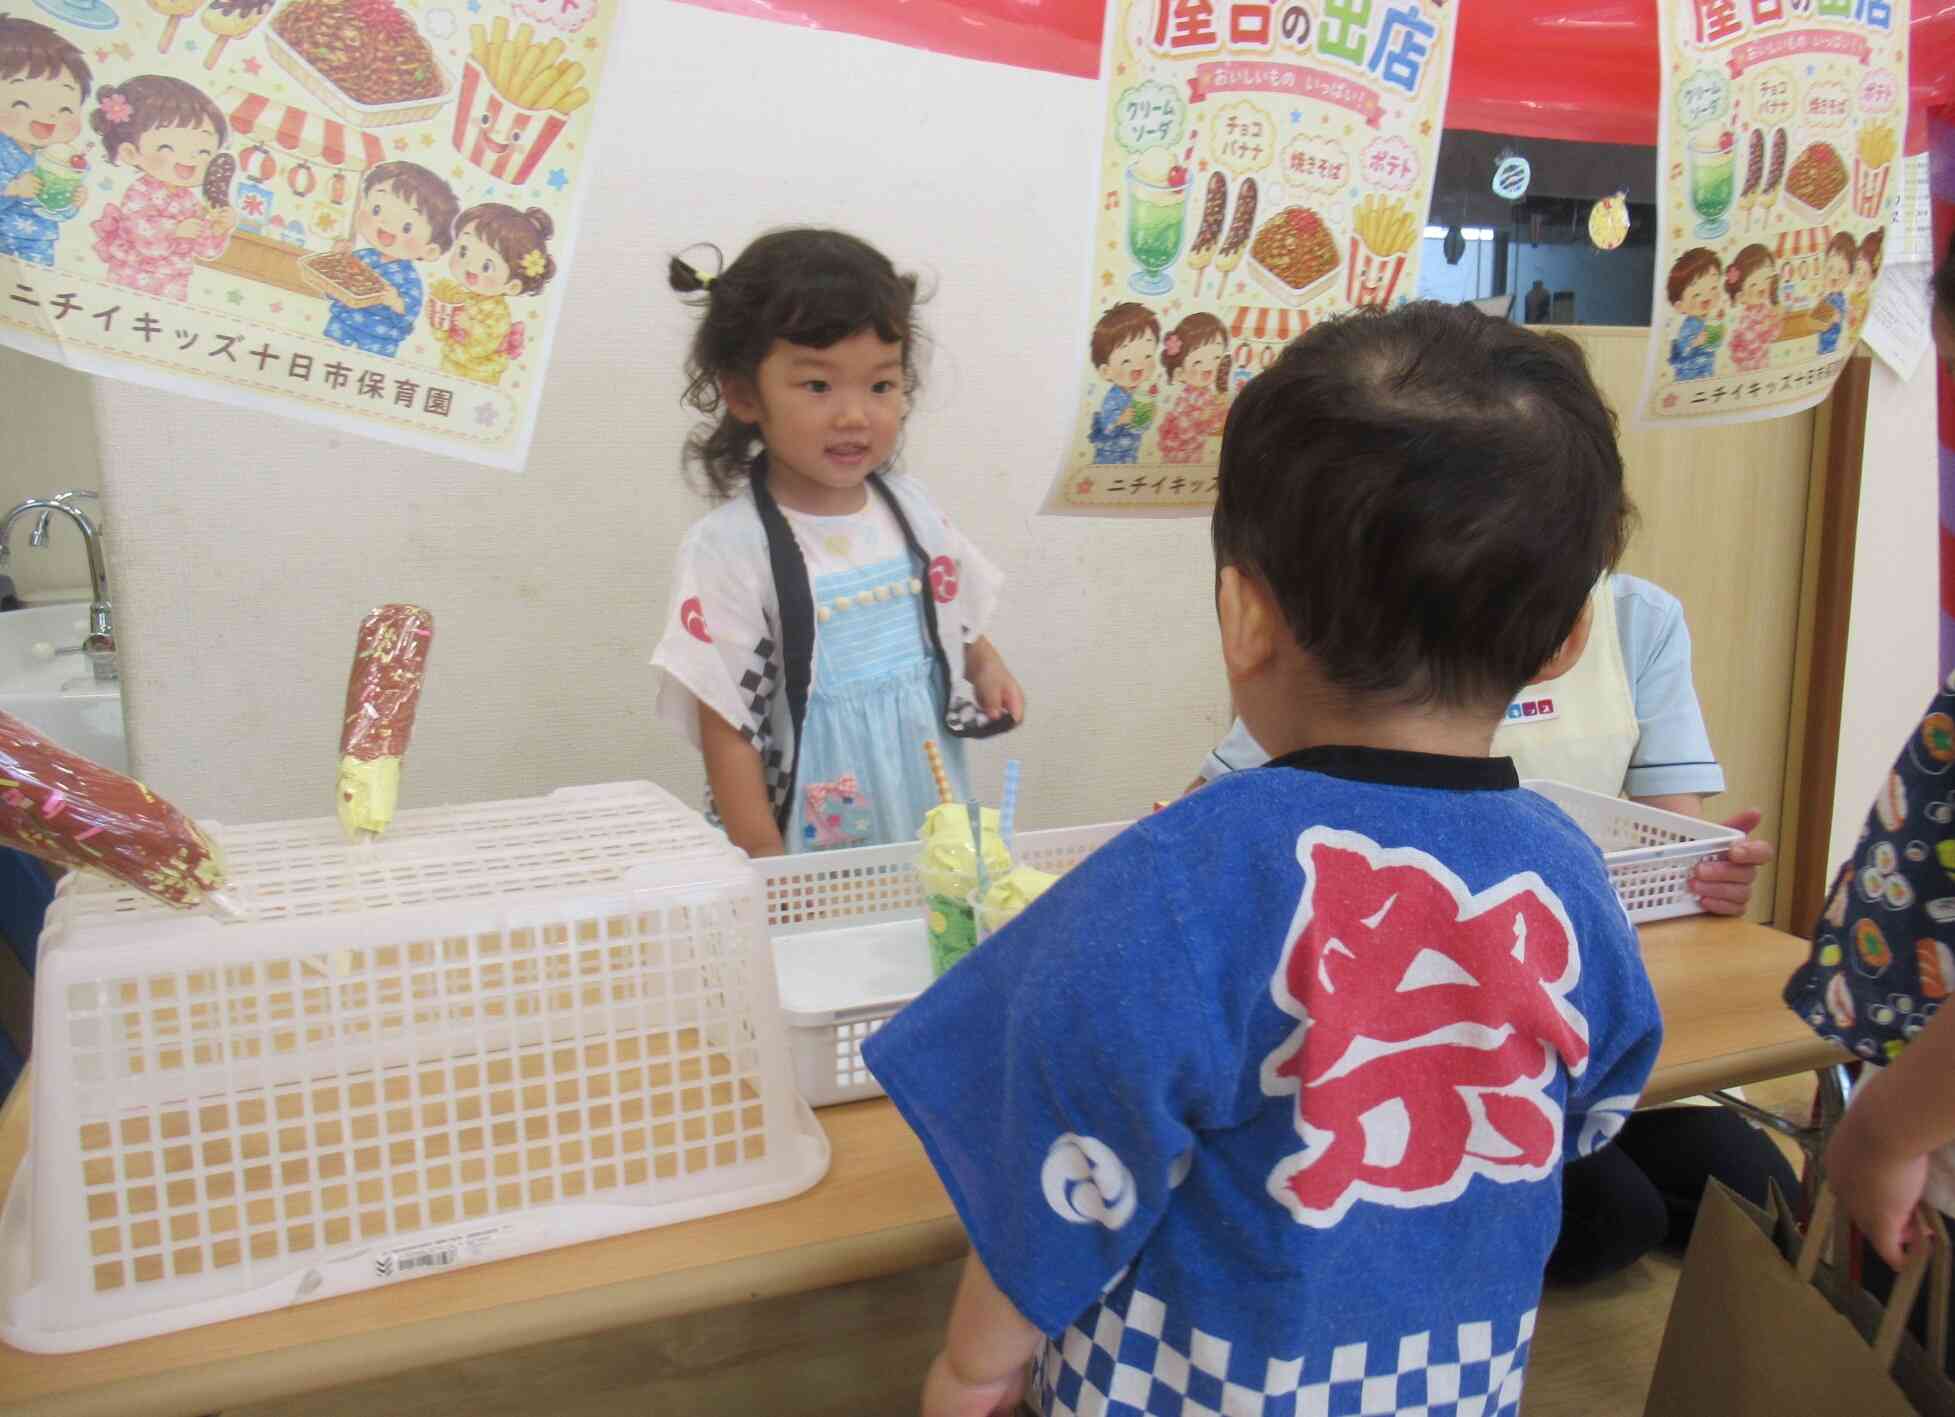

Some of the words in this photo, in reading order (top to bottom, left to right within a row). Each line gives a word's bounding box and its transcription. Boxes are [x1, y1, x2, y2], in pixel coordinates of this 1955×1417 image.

[1214, 68, 1296, 88] おいしいもの
[1127, 100, 1174, 120] クリーム
[1131, 120, 1173, 142] ソーダ
[1226, 116, 1262, 137] チョコ
[1222, 140, 1263, 160] バナナ
[1290, 152, 1344, 180] 焼きそば
[9, 284, 454, 418] ニチイキッズ十日市保育園
[1261, 826, 1589, 1228] 祭
